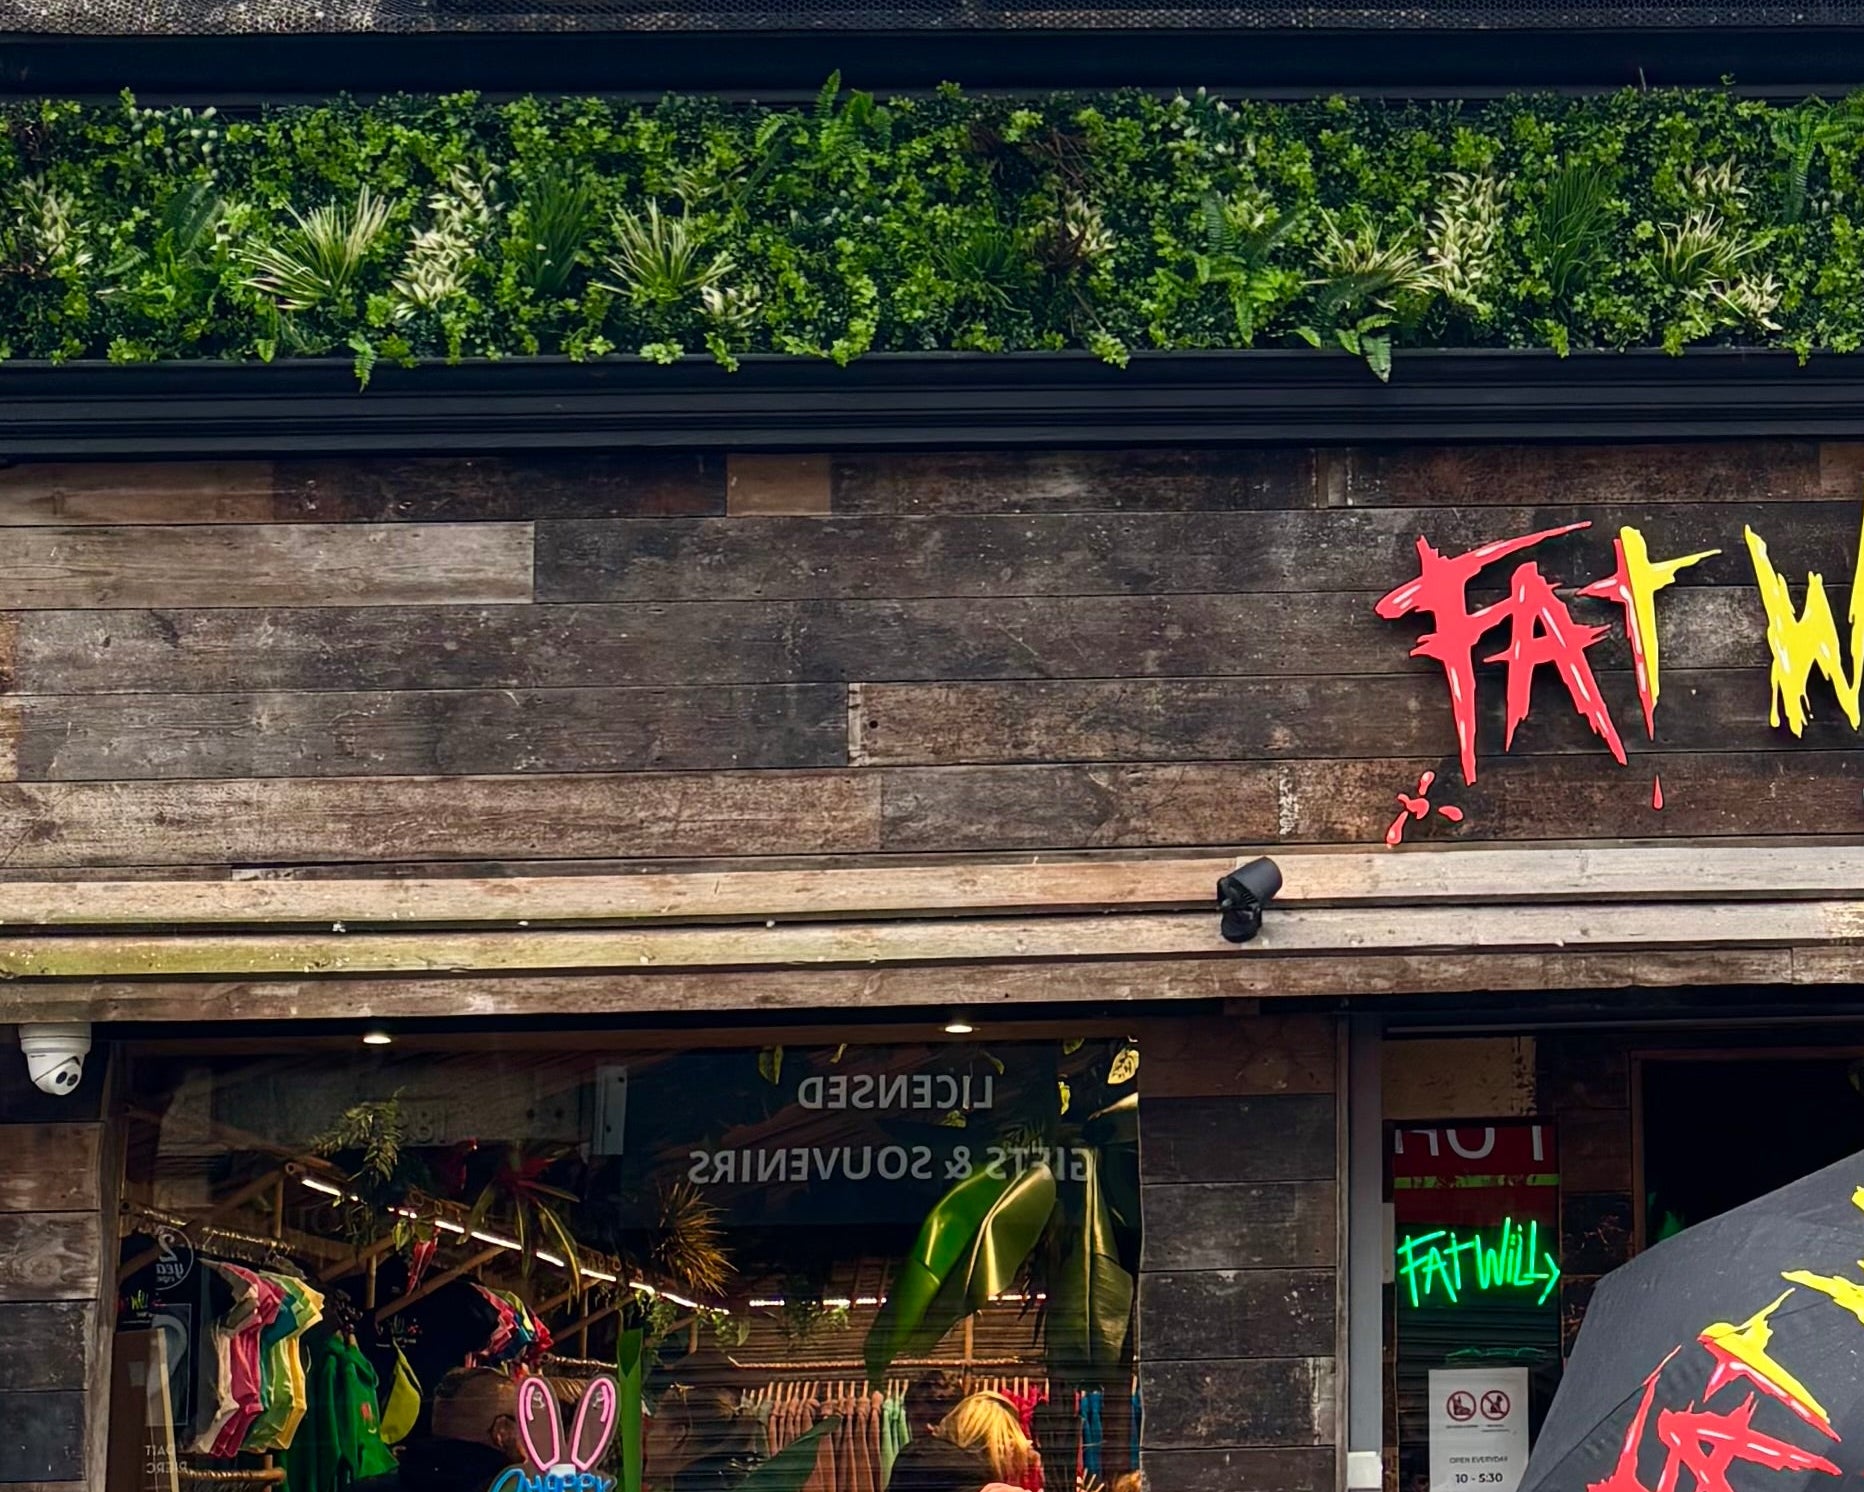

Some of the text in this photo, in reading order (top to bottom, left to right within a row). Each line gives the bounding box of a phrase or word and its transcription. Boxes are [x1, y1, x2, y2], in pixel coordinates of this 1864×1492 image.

[1374, 519, 1722, 787] FAT
[1396, 1230, 1475, 1308] FAT
[1456, 1473, 1468, 1484] 10
[1478, 1473, 1503, 1483] 5:30
